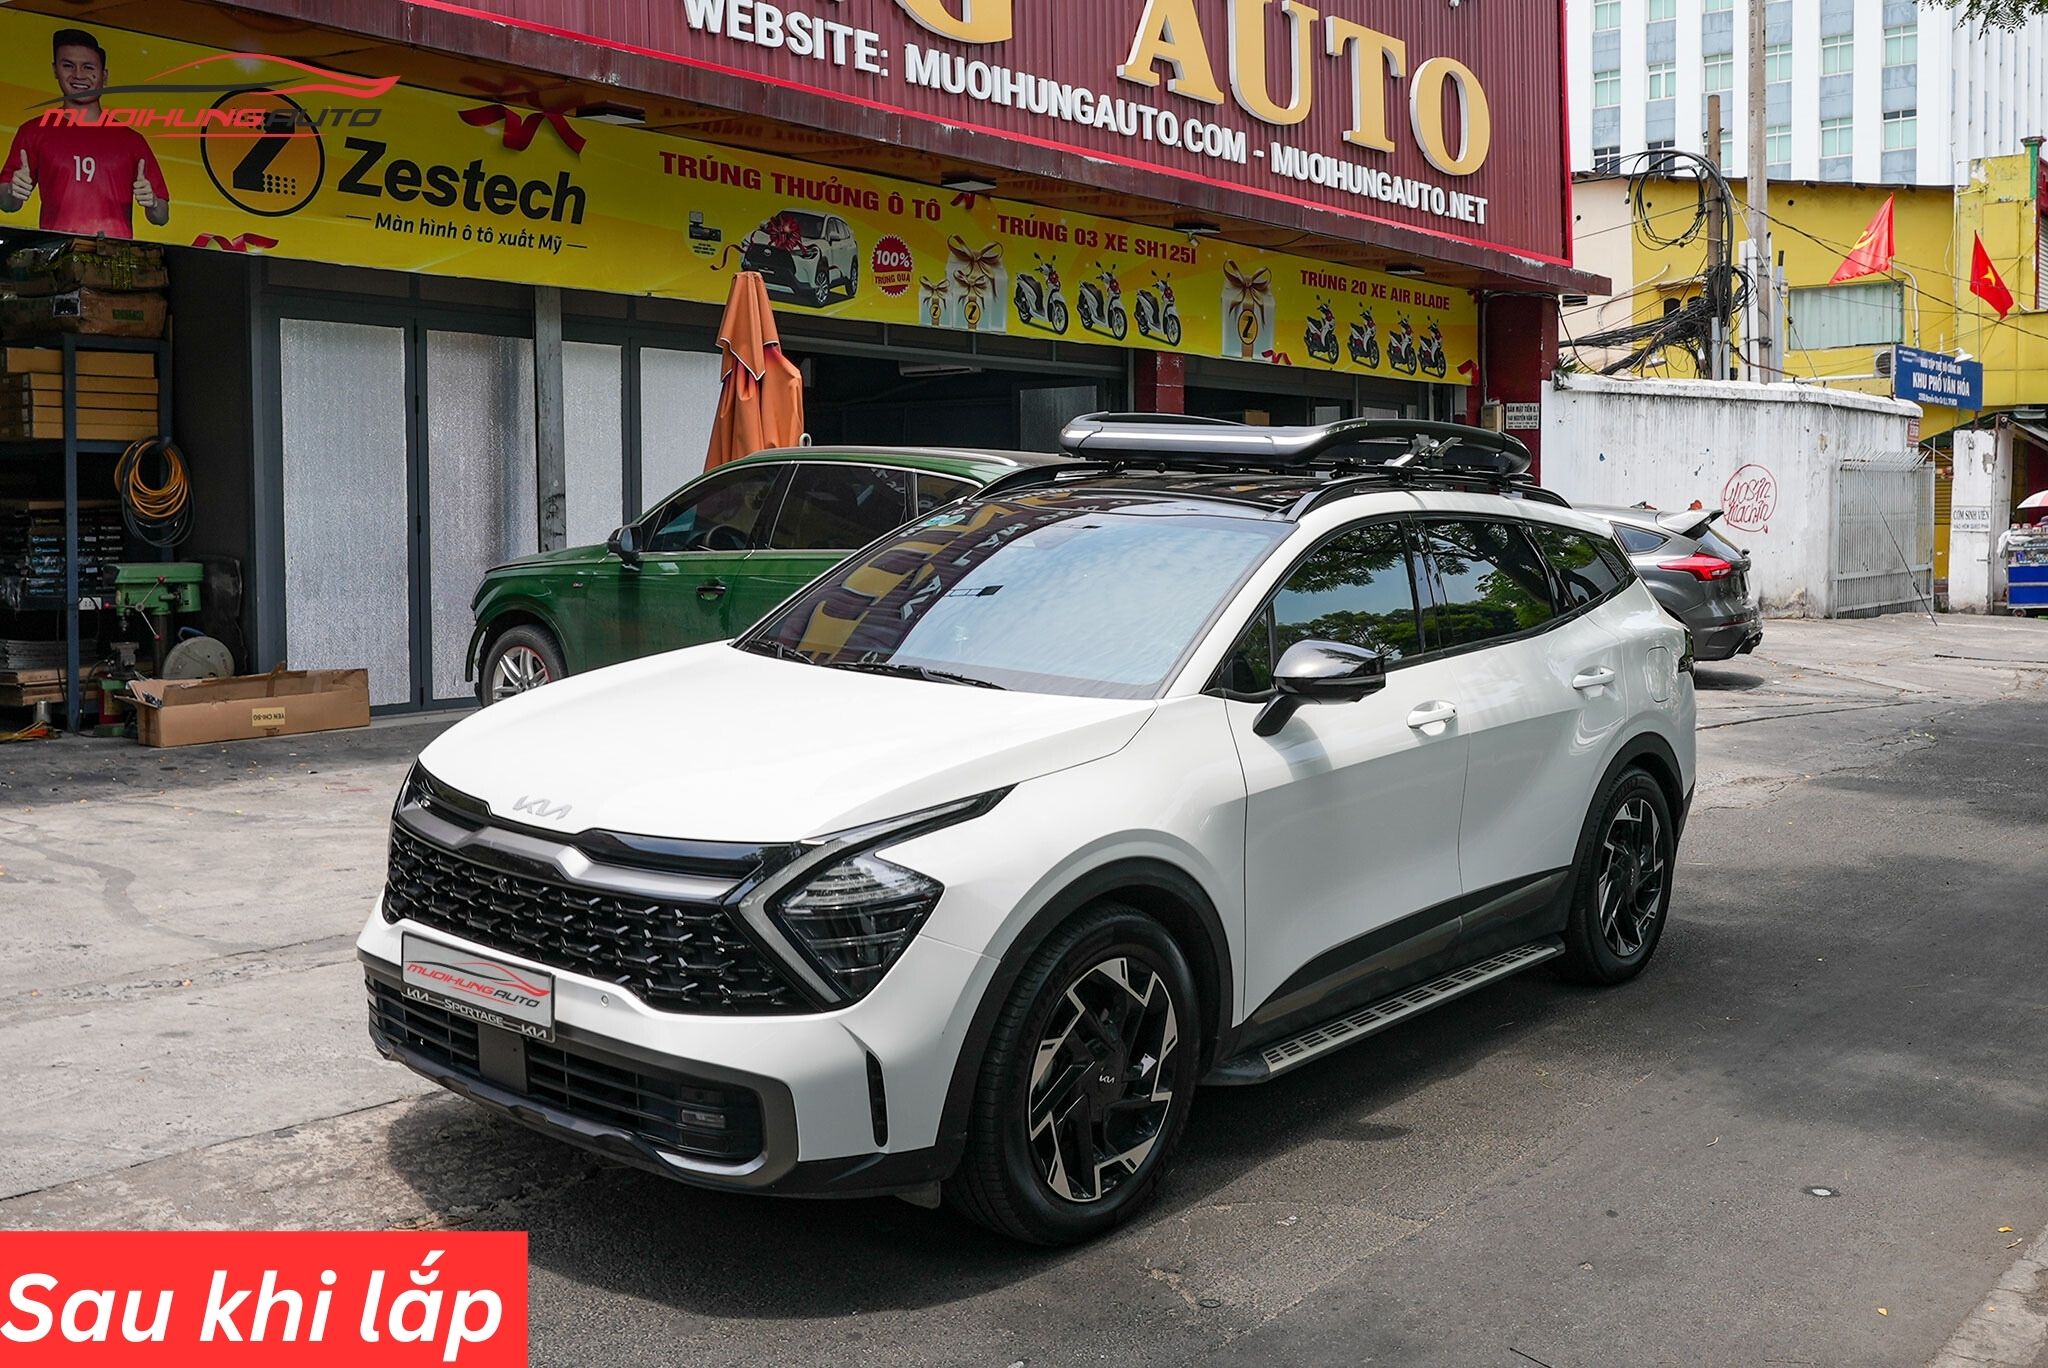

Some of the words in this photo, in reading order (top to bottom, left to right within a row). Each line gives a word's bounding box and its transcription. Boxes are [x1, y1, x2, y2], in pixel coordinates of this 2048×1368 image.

[1116, 0, 1491, 176] AUTO
[683, 0, 888, 77] WEBSITE:
[905, 43, 1247, 164] MUOIHUNGAUTO.COM
[1270, 141, 1488, 225] MUOIHUNGAUTO.NET
[73, 155, 96, 183] 19
[337, 136, 586, 225] Zestech
[659, 151, 761, 190] TRÚNG
[771, 172, 879, 212] THƯỞNG
[889, 192, 904, 215] Ô
[912, 198, 941, 222] TÔ
[375, 212, 413, 233] Màn
[419, 217, 457, 239] hình
[462, 225, 472, 242] ô
[477, 226, 494, 243] tô
[498, 228, 535, 249] xuất
[538, 234, 562, 255] Mỹ
[997, 213, 1068, 243] TRÚNG
[1074, 228, 1098, 248] 03
[1104, 232, 1128, 253] XE
[876, 250, 910, 268] 100%
[1300, 269, 1347, 291] TRÚNG
[1351, 279, 1367, 295] 20
[1371, 283, 1387, 299] XE
[1390, 287, 1411, 304] AIR
[1414, 292, 1450, 310] BLADE
[1912, 372, 1927, 389] KHU
[1928, 371, 1942, 392] PHỐ
[1942, 376, 1956, 394] VĂN
[1956, 378, 1970, 397] HÓA
[512, 795, 572, 820] KIA
[407, 987, 429, 1001] KIA
[444, 998, 504, 1025] SPORTAGE
[521, 1024, 547, 1039] KIA
